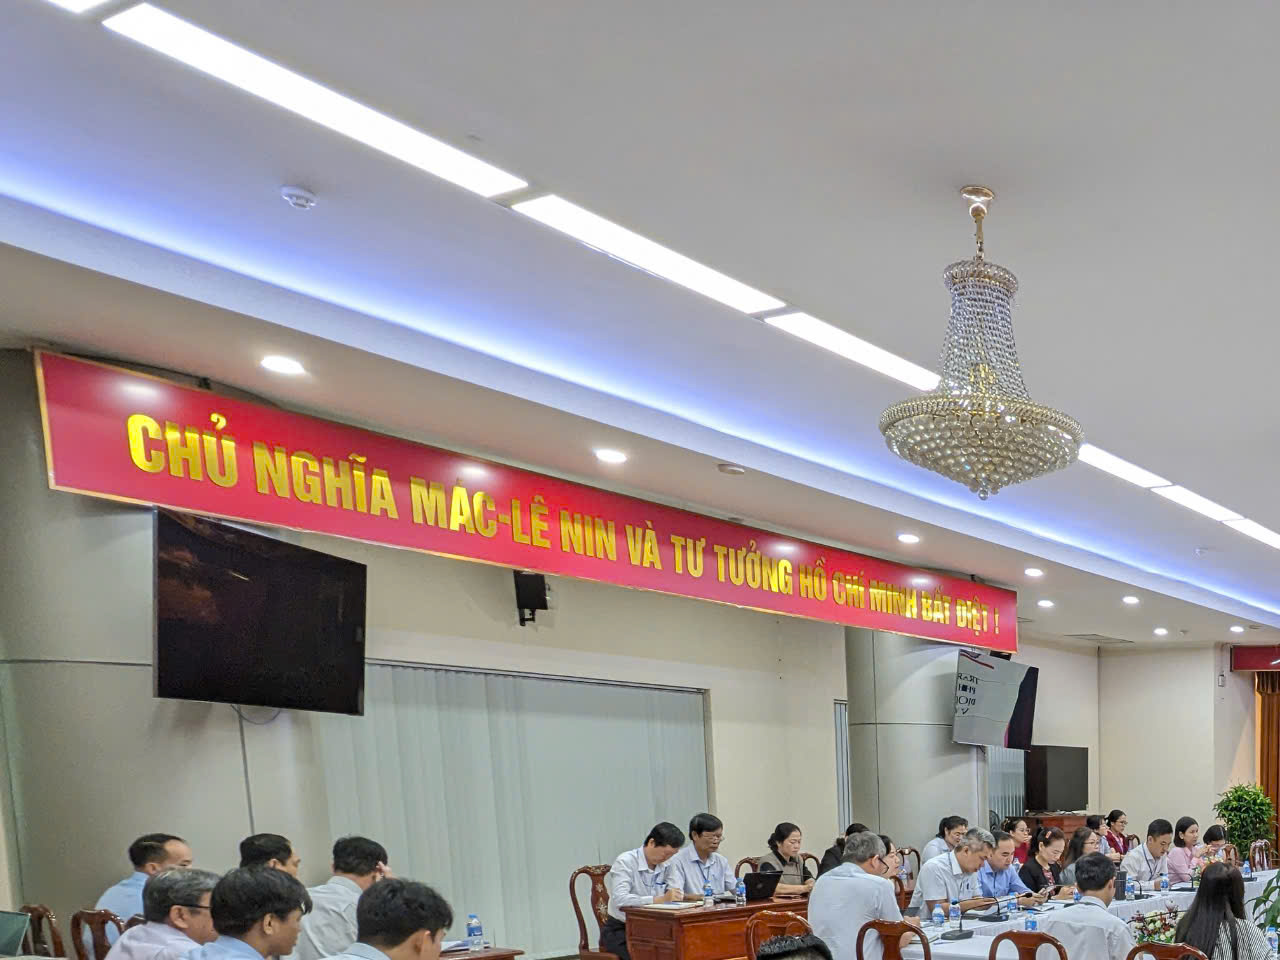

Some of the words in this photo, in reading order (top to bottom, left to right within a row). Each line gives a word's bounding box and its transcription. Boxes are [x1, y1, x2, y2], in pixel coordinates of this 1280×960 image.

[127, 412, 239, 488] CHỦ
[252, 441, 399, 520] NGHĨA
[559, 509, 617, 561] NIN
[625, 520, 663, 570] VÀ
[670, 534, 707, 578] TƯ
[713, 539, 793, 595] TƯỞNG
[799, 556, 828, 601] HỒ
[832, 571, 865, 609] CHÍ
[869, 579, 918, 619] MINH
